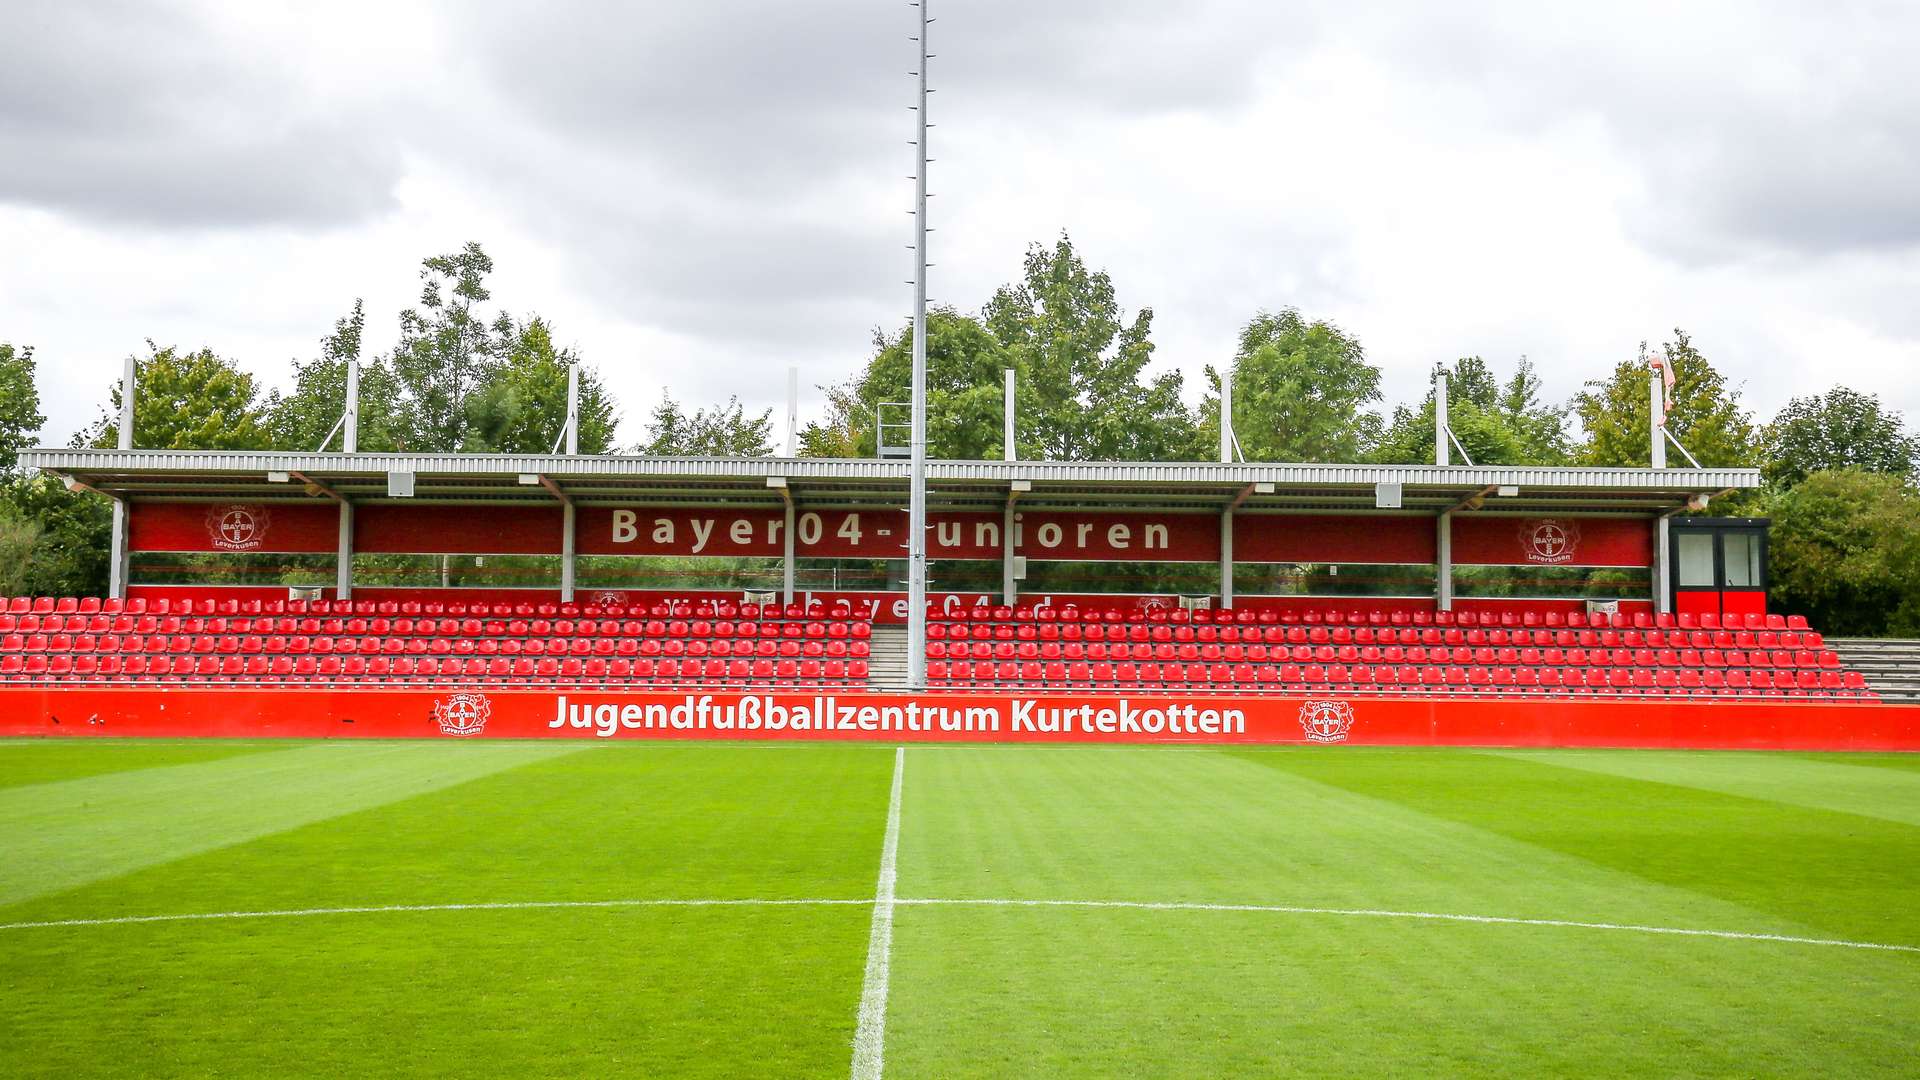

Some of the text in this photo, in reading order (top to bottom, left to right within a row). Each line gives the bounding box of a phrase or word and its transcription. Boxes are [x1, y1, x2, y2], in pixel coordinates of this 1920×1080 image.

[612, 510, 1168, 553] Bayer04-unioren
[215, 540, 259, 549] Leverkusen
[1528, 553, 1571, 562] Leverkusen
[549, 695, 1245, 736] Jugendfußballzentrum Kurtekotten
[443, 726, 481, 735] Leverkusen
[1308, 733, 1345, 742] Leverkusen
